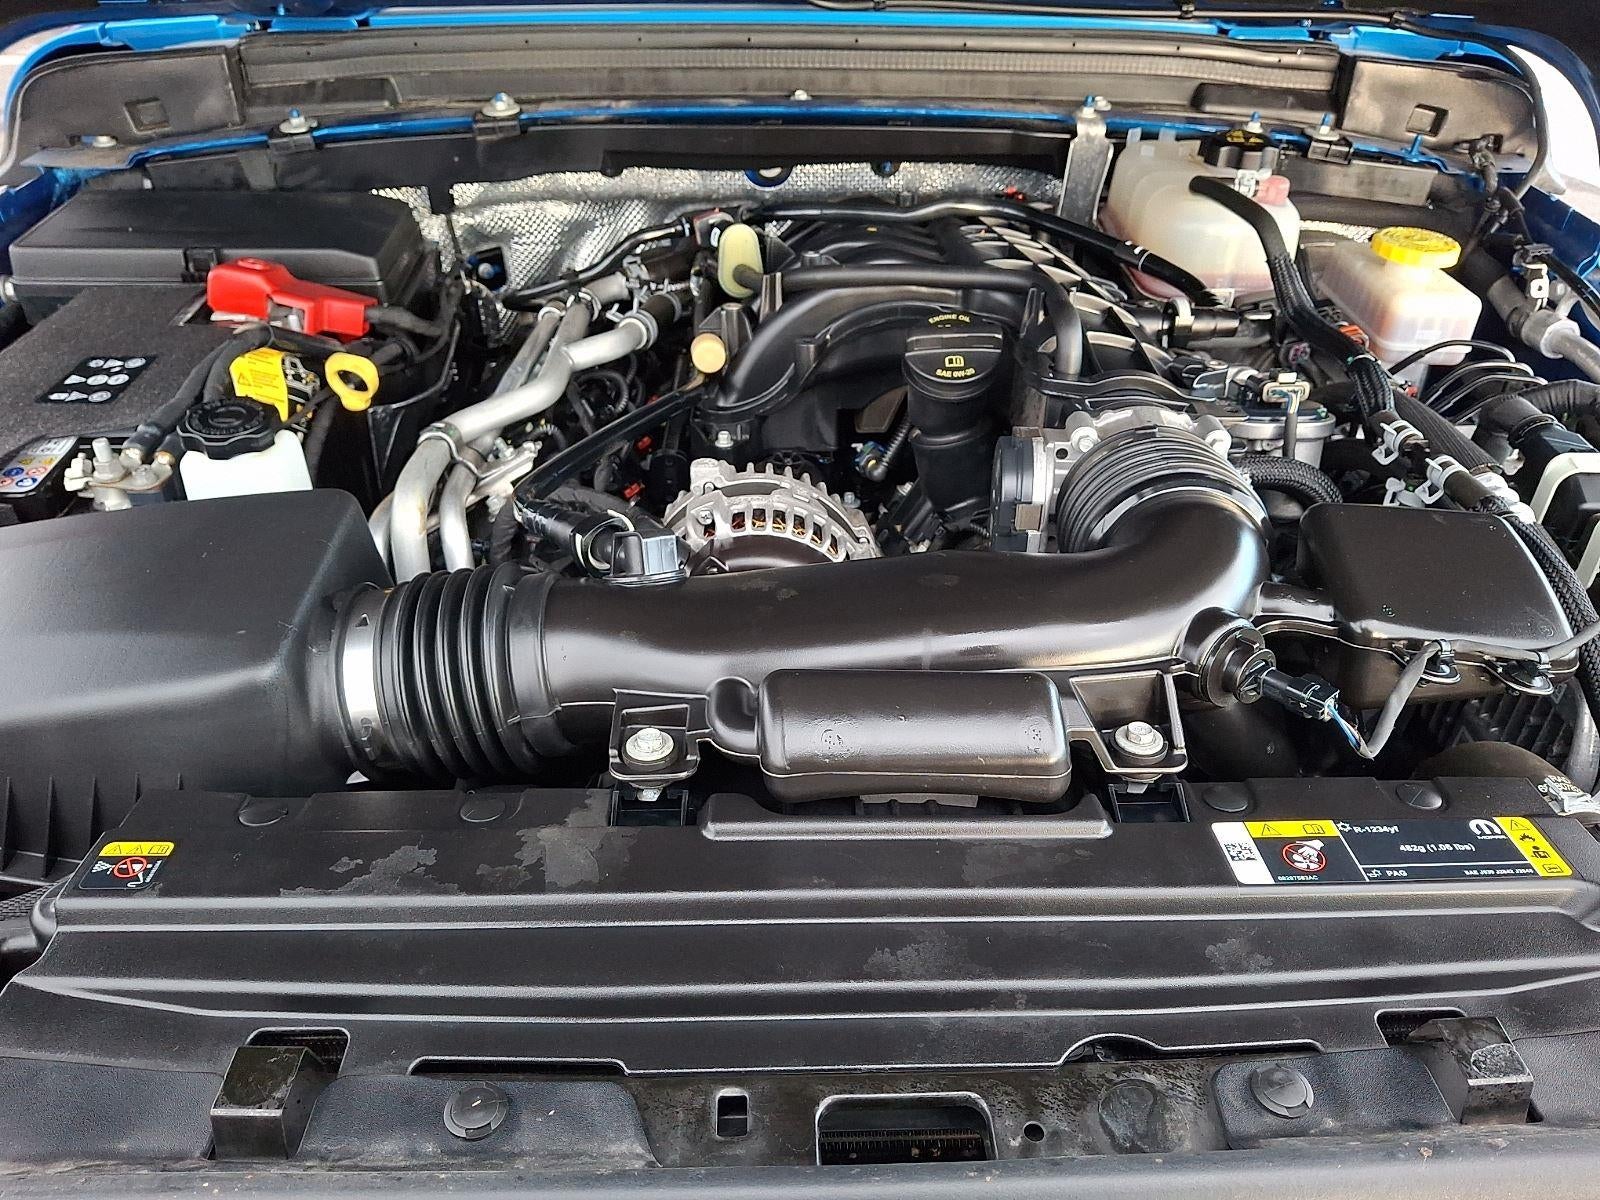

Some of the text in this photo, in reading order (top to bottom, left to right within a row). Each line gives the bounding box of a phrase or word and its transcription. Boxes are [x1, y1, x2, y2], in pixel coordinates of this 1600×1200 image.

[928, 314, 971, 324] ENGINE OIL
[936, 368, 952, 377] SAE
[1353, 825, 1399, 834] R-1234yf
[1386, 869, 1408, 877] PAG
